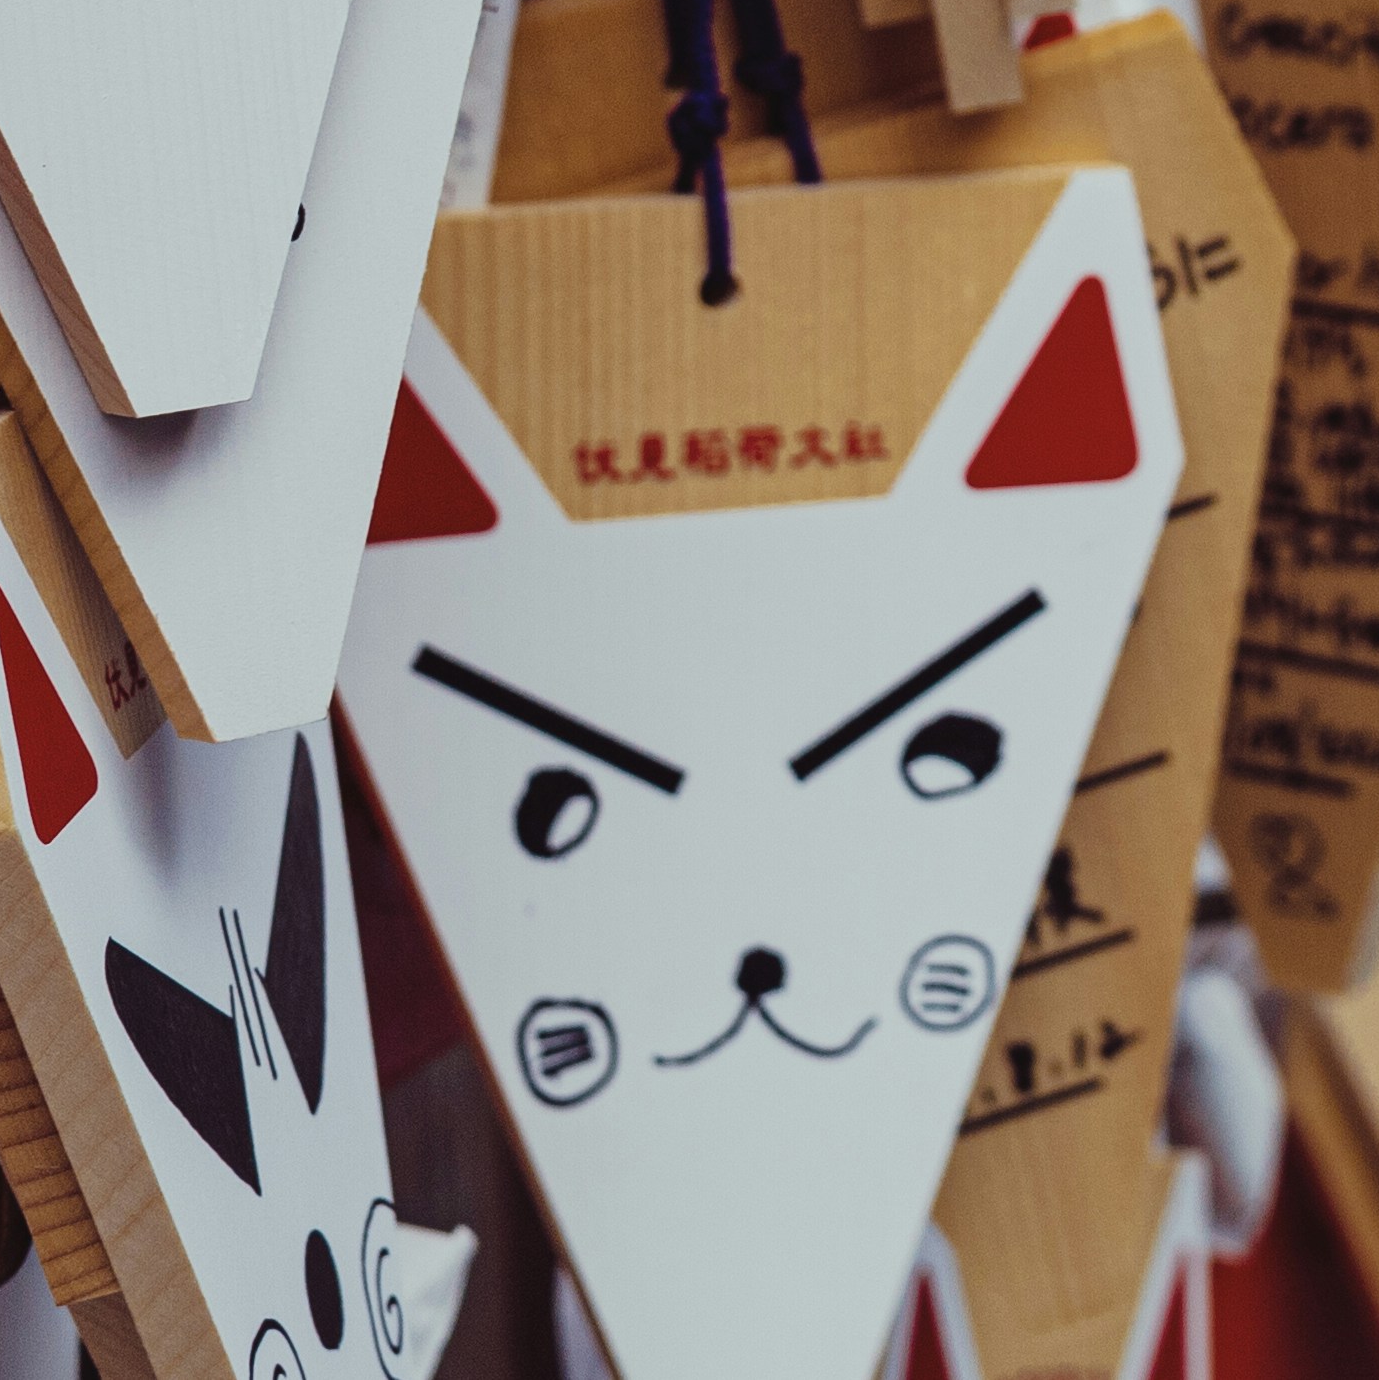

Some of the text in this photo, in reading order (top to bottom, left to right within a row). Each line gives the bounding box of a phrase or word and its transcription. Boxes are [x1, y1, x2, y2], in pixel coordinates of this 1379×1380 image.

[571, 419, 890, 488] 伏見稲荷大社
